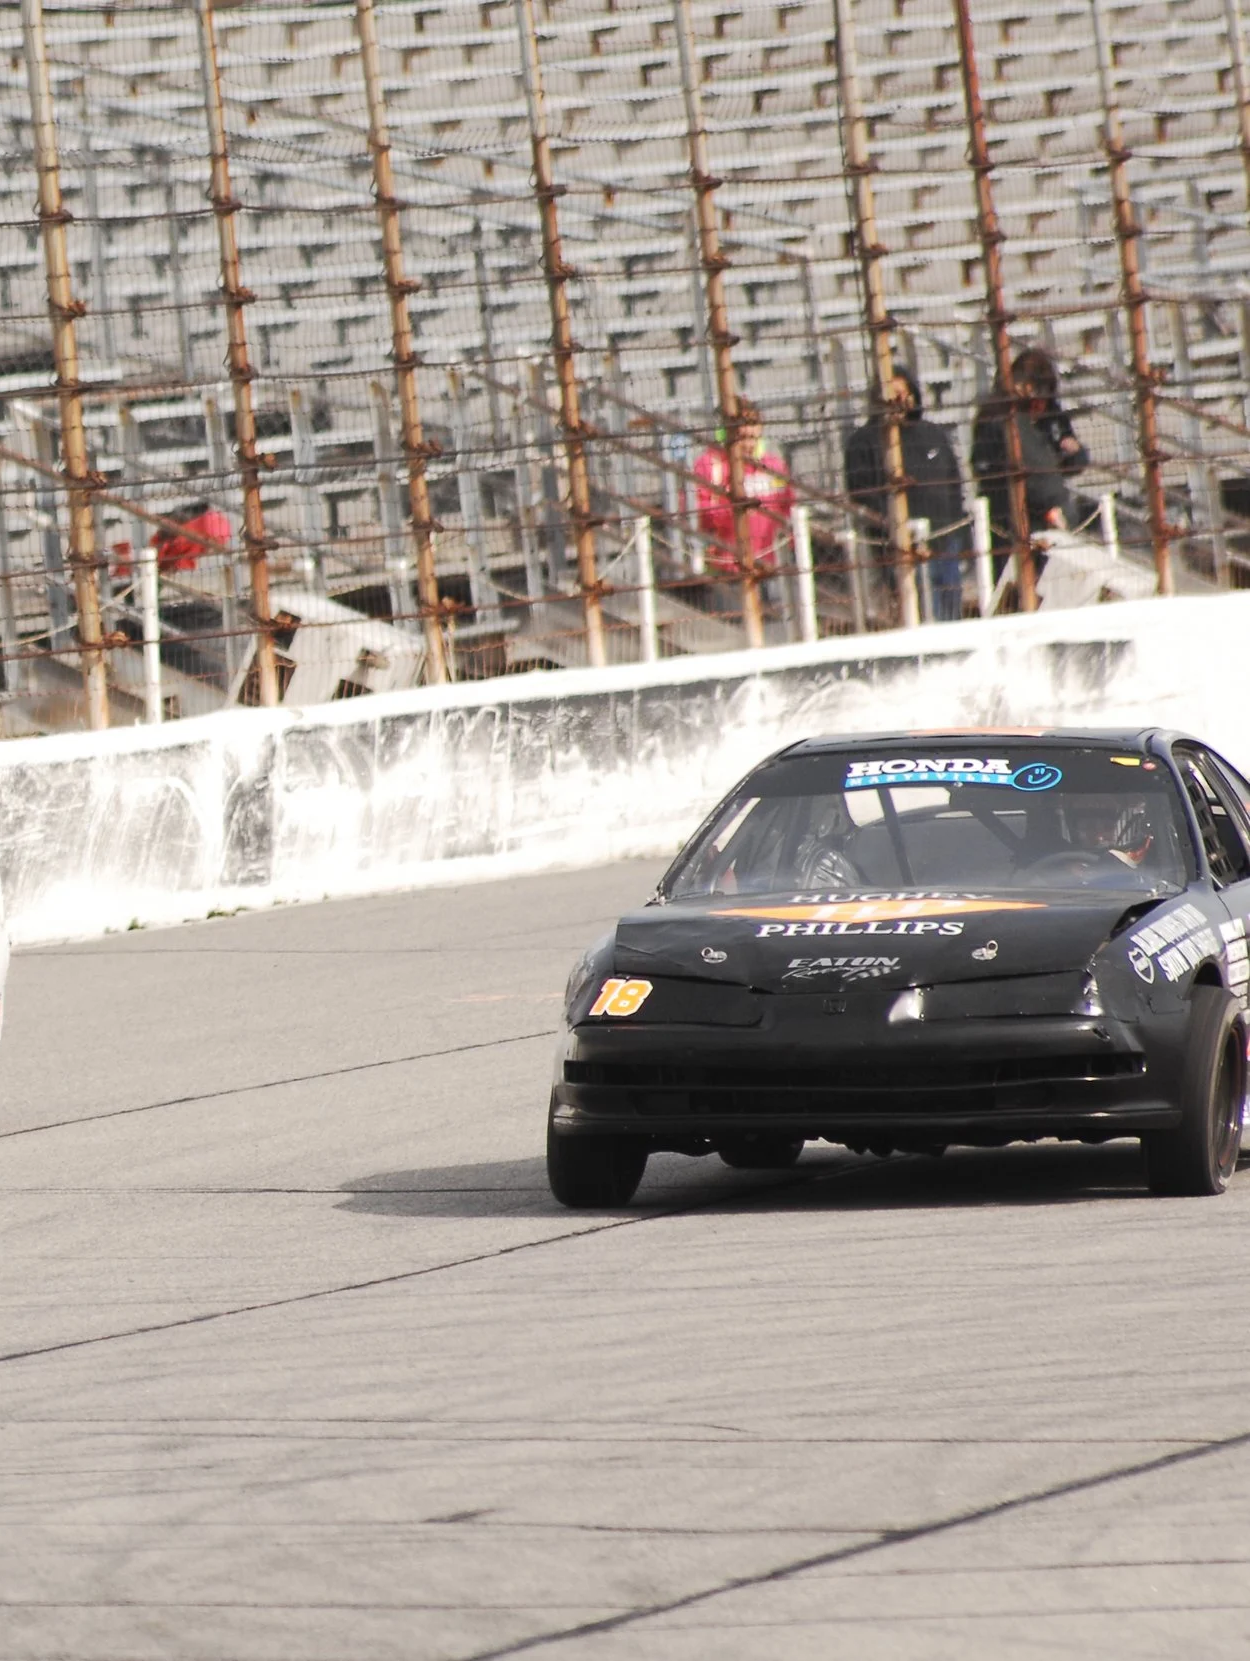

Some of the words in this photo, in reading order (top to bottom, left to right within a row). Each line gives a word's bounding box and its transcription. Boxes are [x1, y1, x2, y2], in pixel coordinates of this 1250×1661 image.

[847, 758, 1013, 778] HONDA
[849, 772, 1009, 787] MARYSVILLE
[787, 891, 995, 904] HUGHEY
[755, 921, 965, 938] PHILLIPS
[788, 957, 900, 969] EATON
[588, 978, 654, 1017] 18
